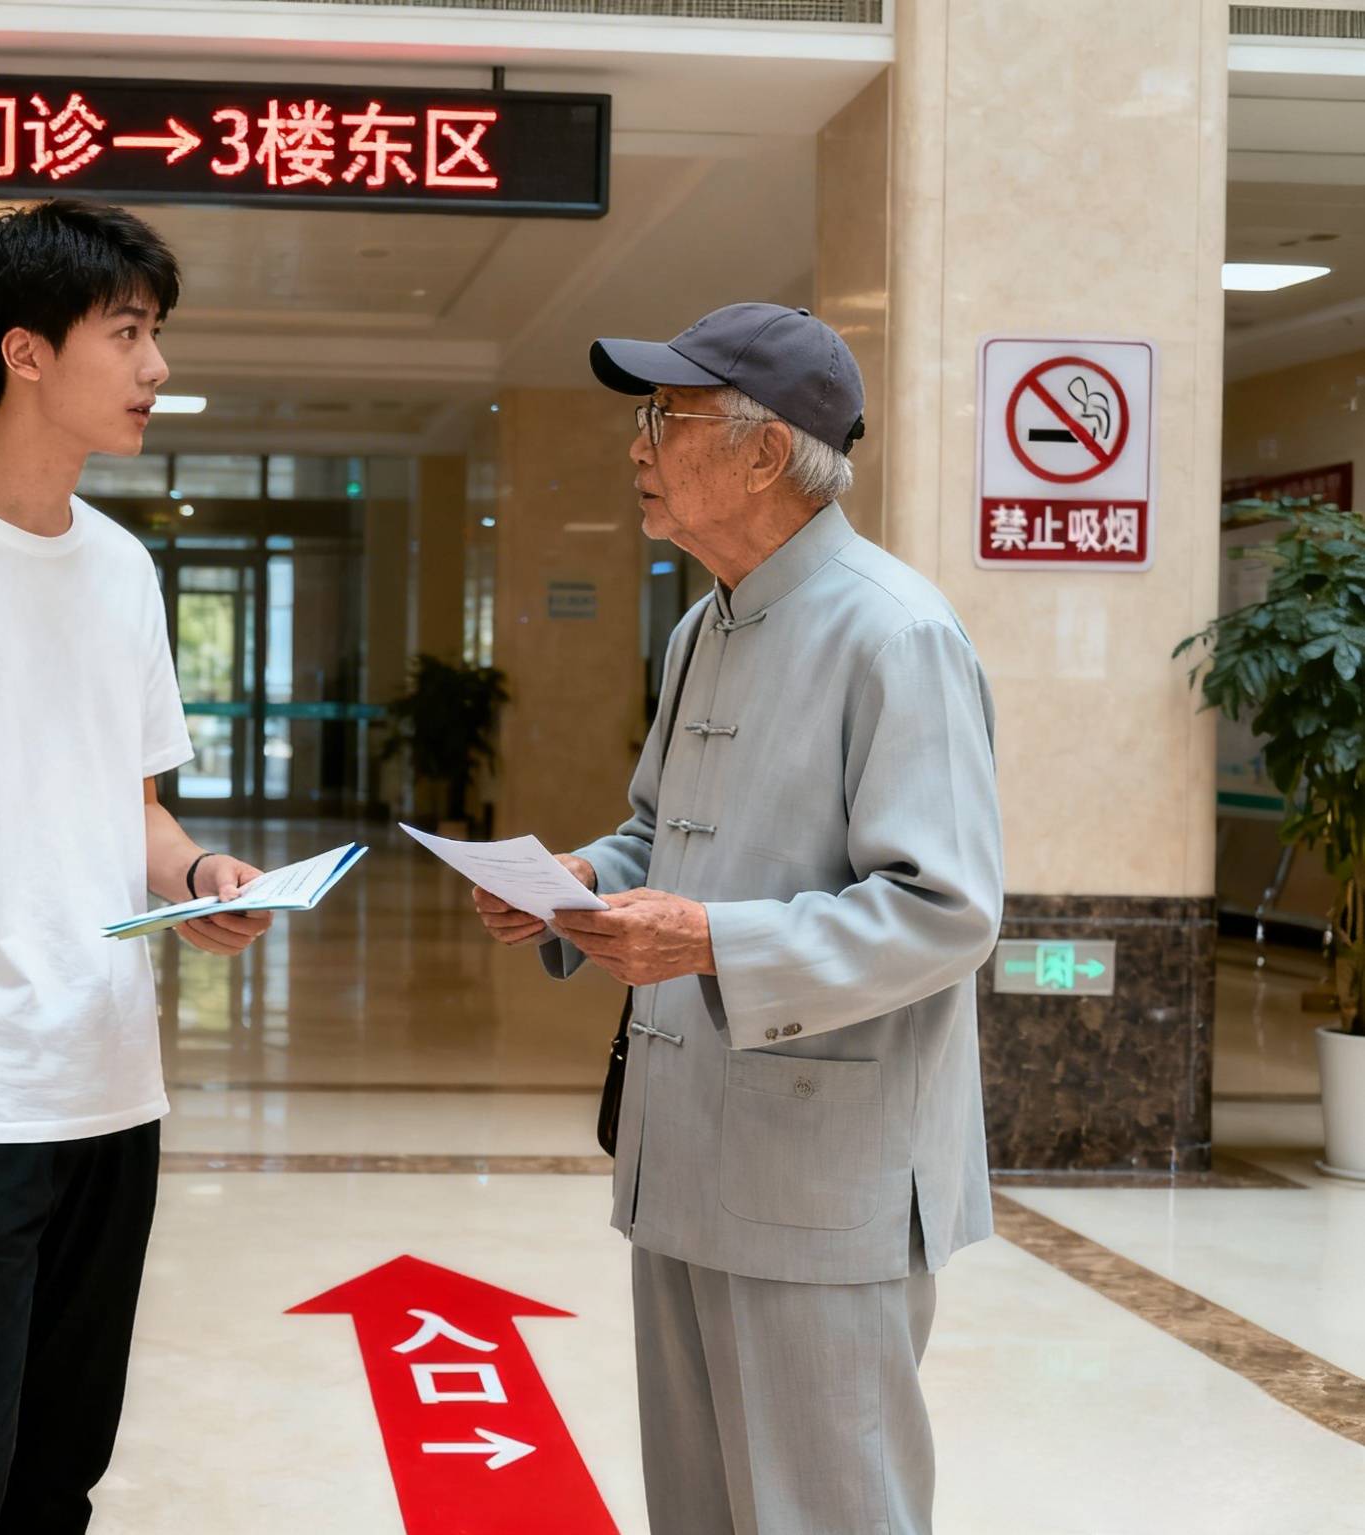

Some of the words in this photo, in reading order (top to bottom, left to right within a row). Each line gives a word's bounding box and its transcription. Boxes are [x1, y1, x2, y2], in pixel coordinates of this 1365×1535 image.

[989, 506, 1139, 554] 禁止吸烟
[391, 1308, 509, 1404] 入口
